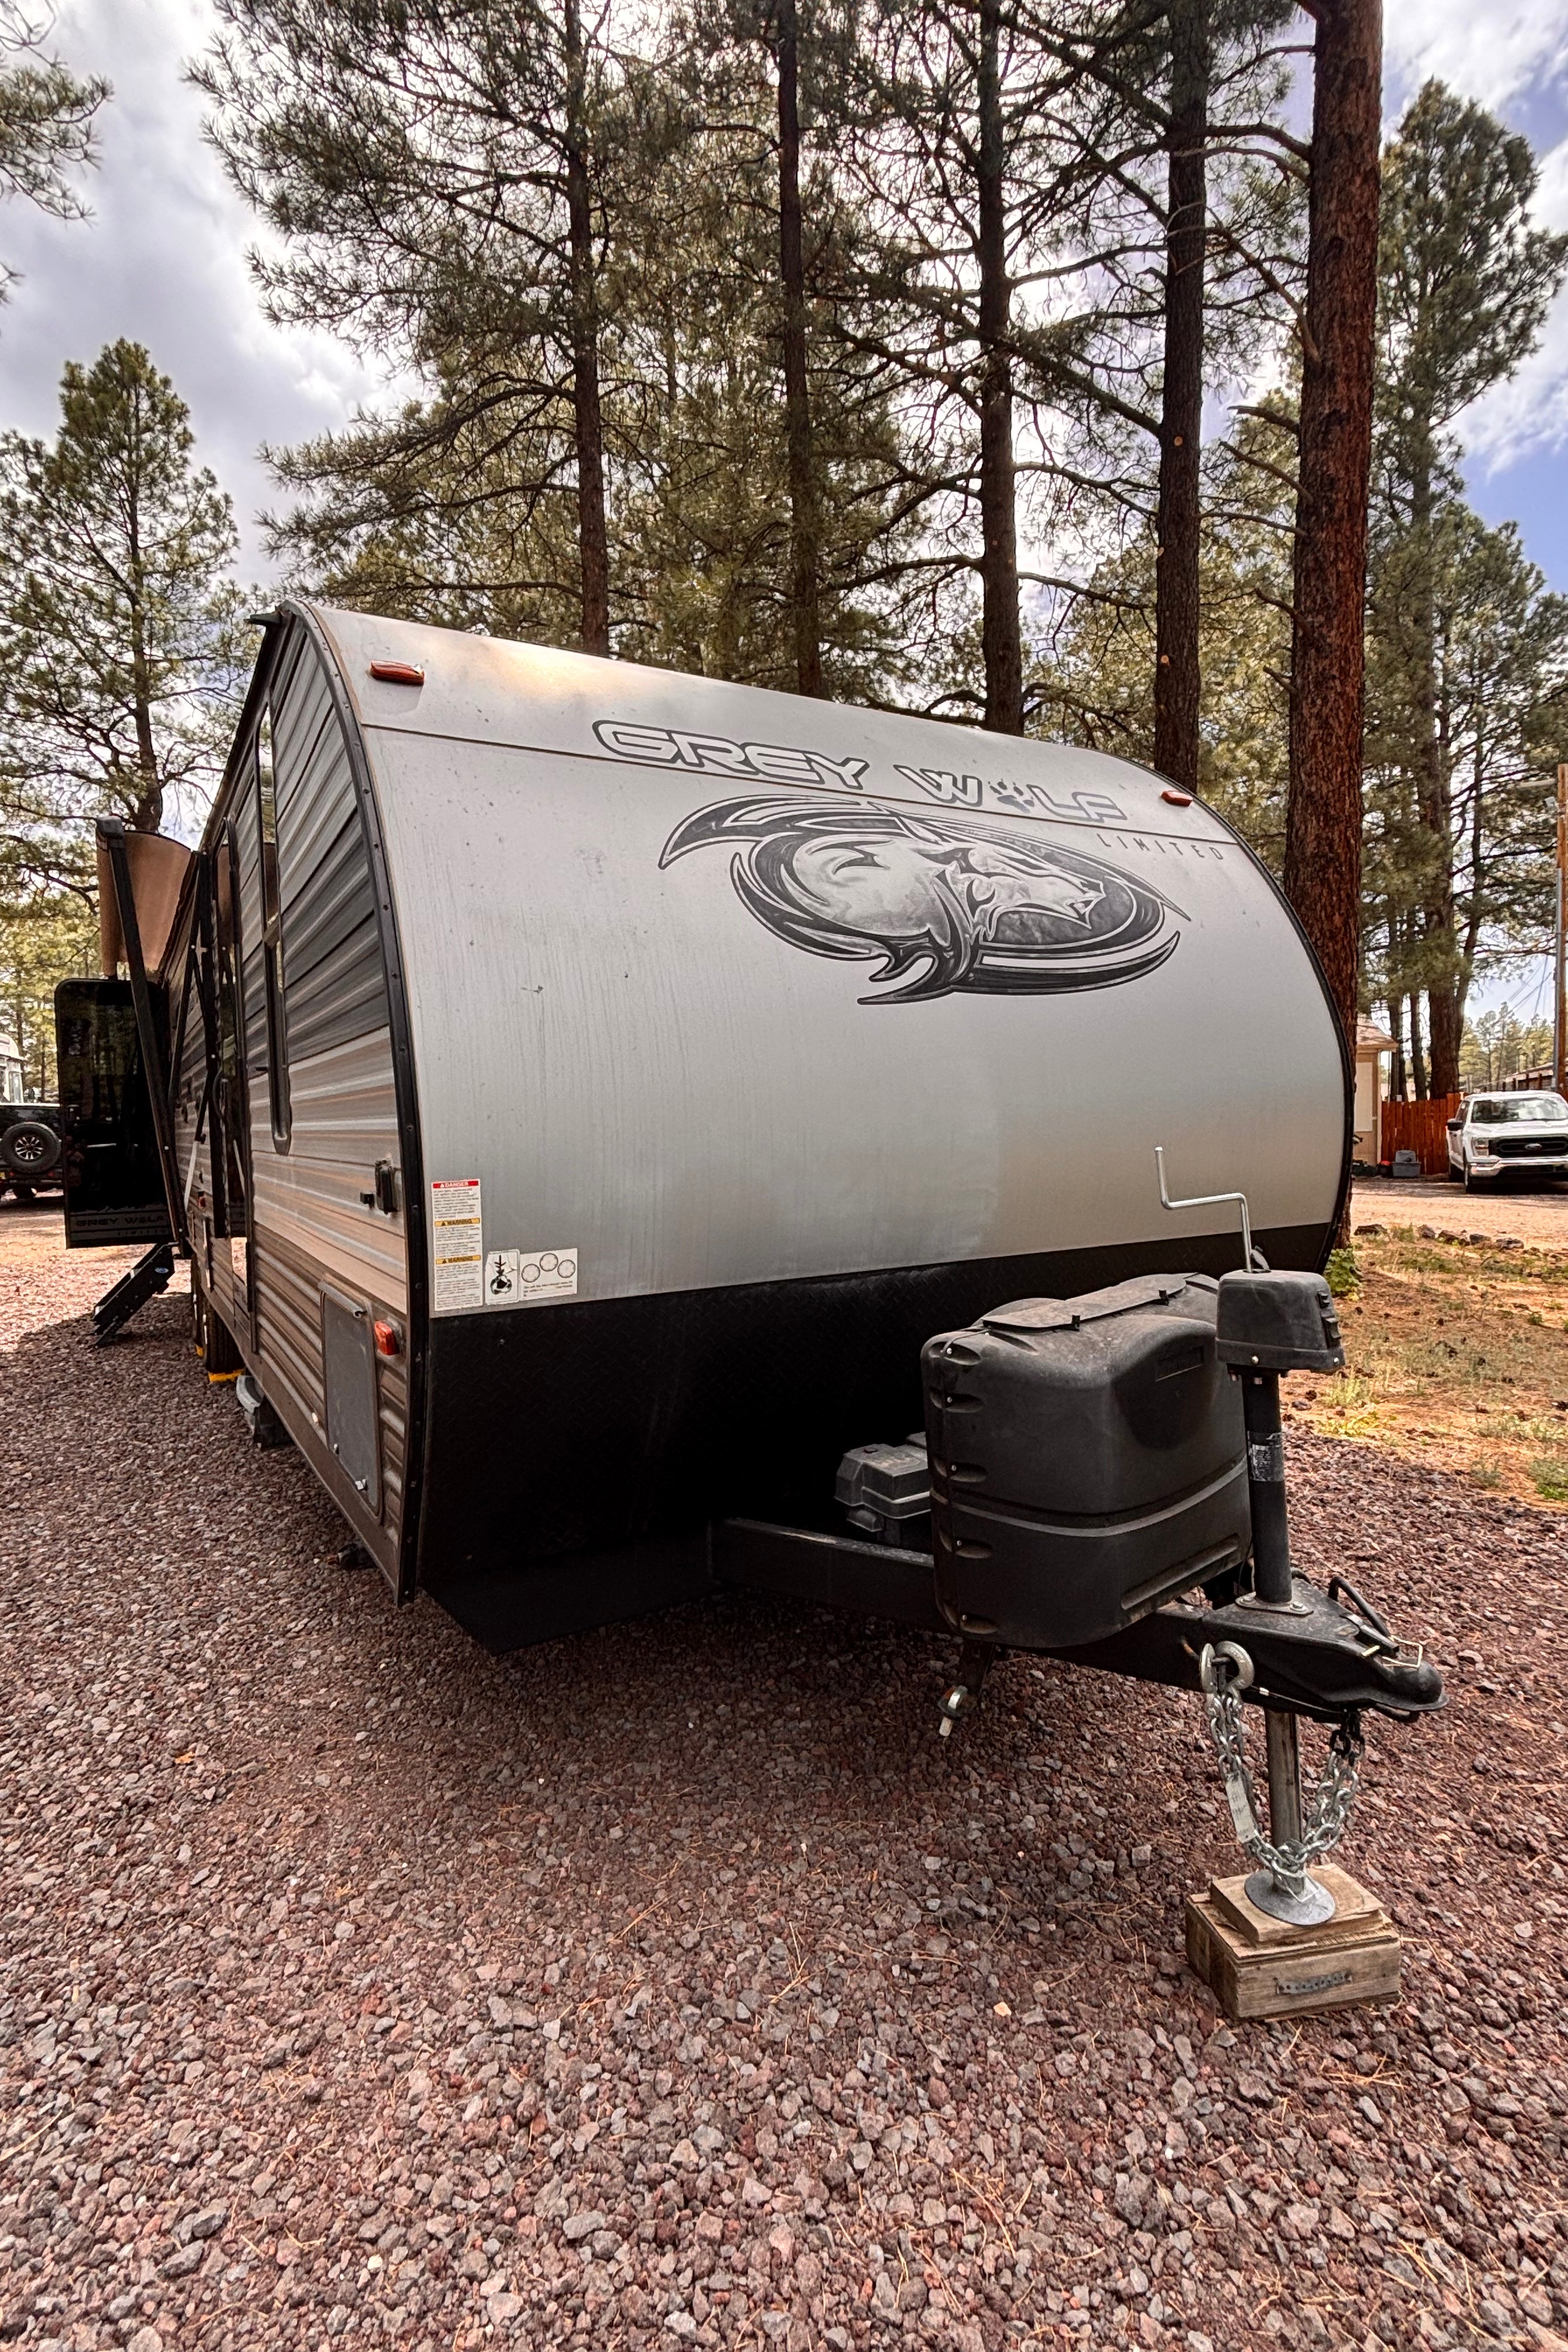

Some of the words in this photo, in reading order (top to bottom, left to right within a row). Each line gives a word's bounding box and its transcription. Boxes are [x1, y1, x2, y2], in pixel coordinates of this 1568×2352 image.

[592, 720, 870, 789] GREY
[1097, 833, 1224, 860] LIMITED
[76, 1217, 118, 1226] GREY
